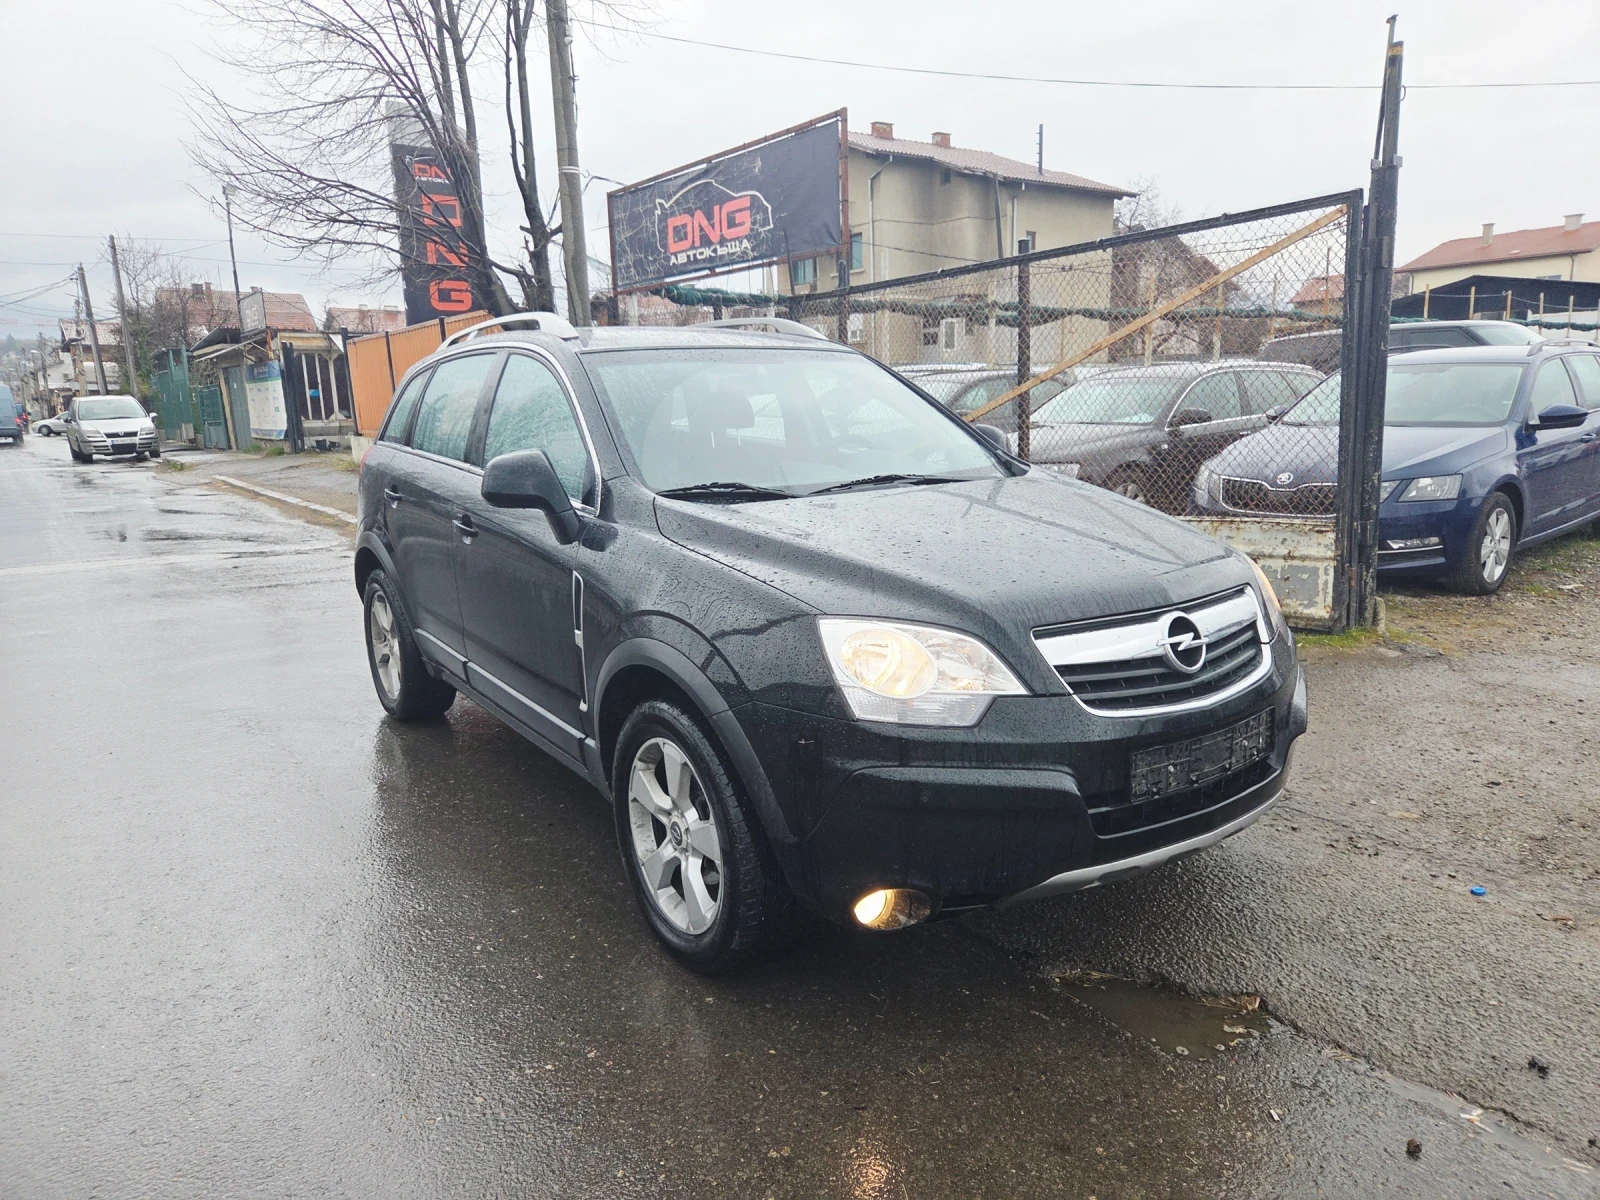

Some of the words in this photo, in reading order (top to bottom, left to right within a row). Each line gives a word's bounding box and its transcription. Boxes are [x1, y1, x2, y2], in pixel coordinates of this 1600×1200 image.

[414, 163, 452, 180] DN
[667, 196, 751, 254] DNG
[669, 239, 751, 266] АВТОКЪЩА
